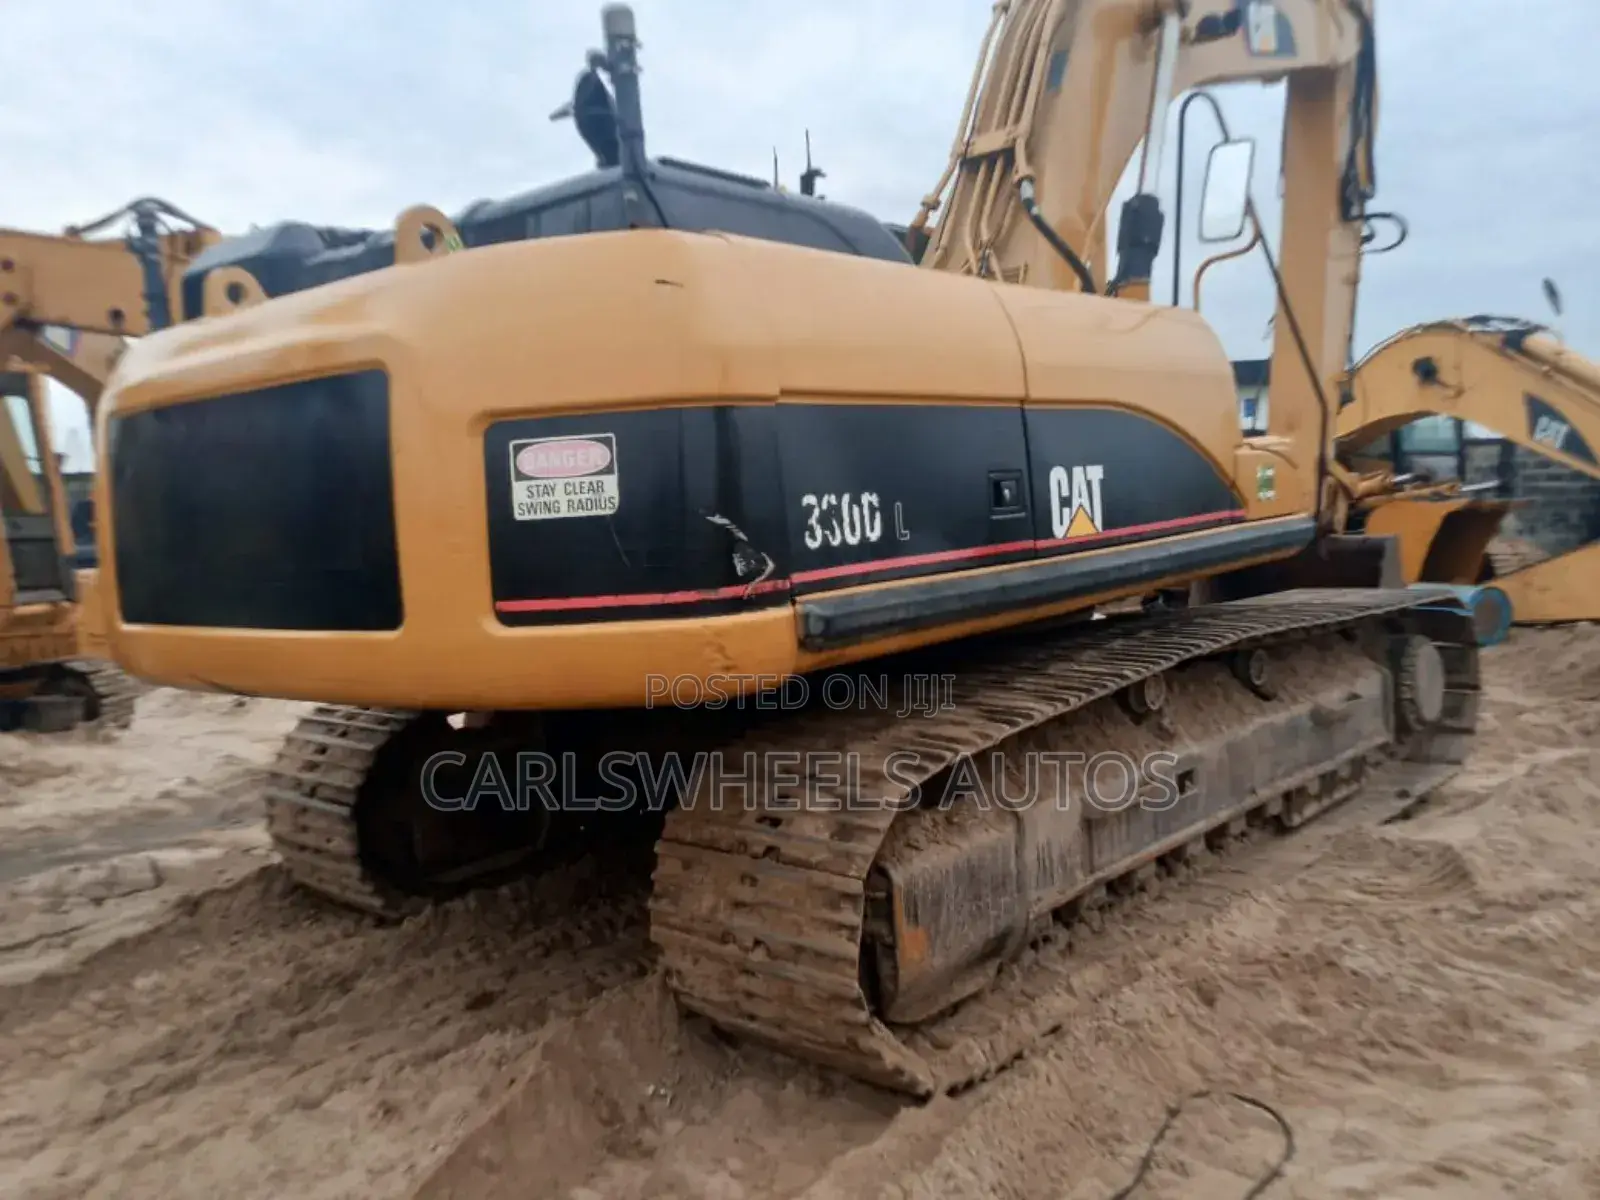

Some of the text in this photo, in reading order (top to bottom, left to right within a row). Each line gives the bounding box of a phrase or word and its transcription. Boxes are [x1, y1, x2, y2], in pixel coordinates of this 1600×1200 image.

[526, 480, 605, 500] STAY CLEAR
[517, 496, 617, 517] SWING RADIUS
[1049, 464, 1105, 539] CAT
